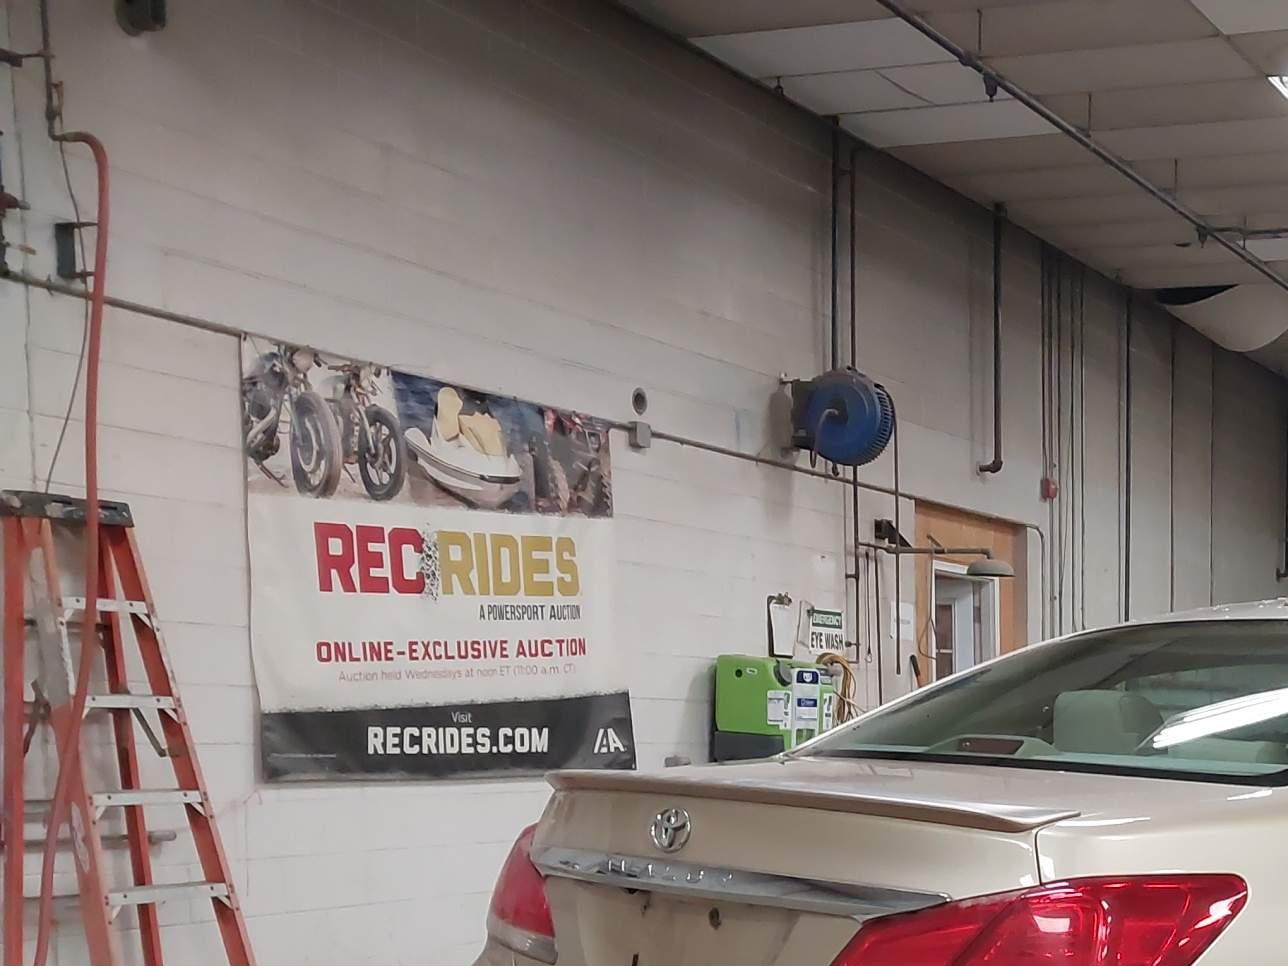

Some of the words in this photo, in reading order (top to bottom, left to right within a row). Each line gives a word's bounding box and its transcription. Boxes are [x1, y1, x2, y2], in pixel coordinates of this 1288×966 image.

[313, 522, 426, 595] REC
[436, 530, 580, 597] RIDES
[479, 604, 486, 620] A
[487, 604, 545, 621] POWERSPORT
[549, 604, 581, 621] AUCTION
[316, 639, 509, 663] ONLINE-EXCLUSIVE
[515, 637, 587, 659] AUCTION
[810, 631, 824, 649] EYE
[825, 632, 844, 651] WASH
[338, 670, 378, 682] Auction
[380, 669, 401, 681] held
[405, 668, 463, 681] Wednesdays
[465, 667, 474, 677] at
[499, 665, 511, 676] ET
[451, 711, 472, 724] Visit
[367, 726, 549, 755] RECRIDES.COM
